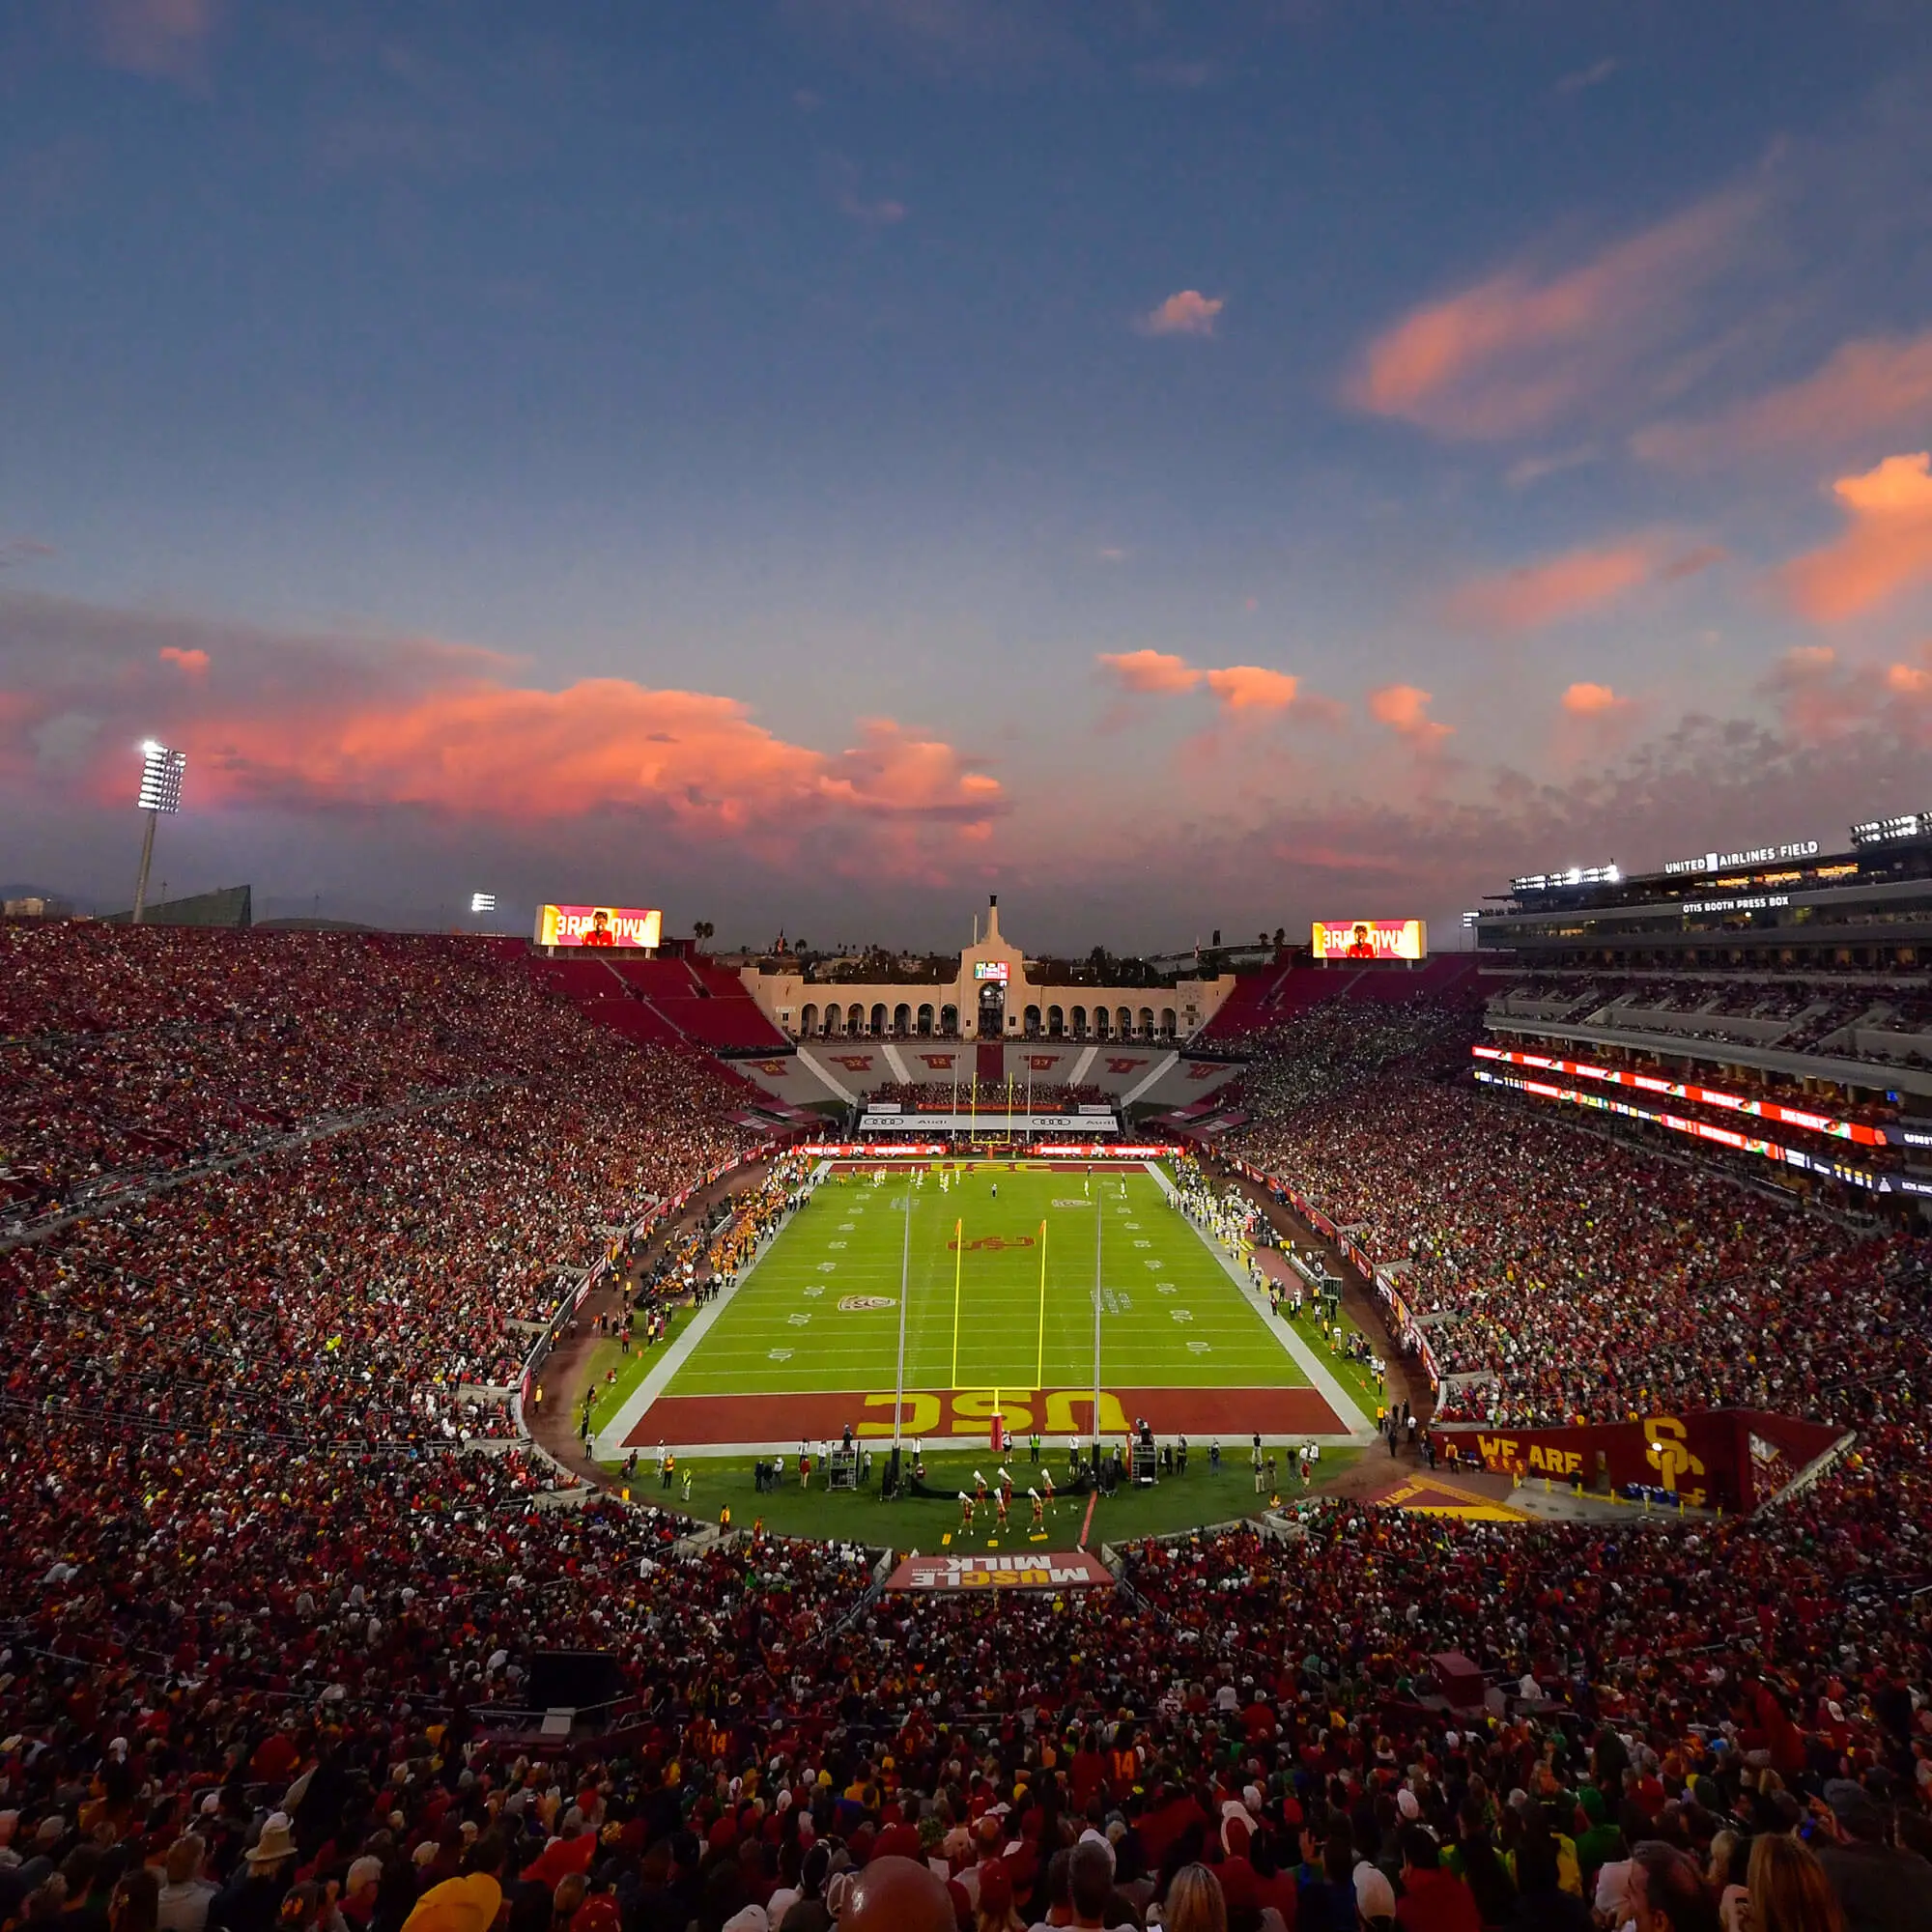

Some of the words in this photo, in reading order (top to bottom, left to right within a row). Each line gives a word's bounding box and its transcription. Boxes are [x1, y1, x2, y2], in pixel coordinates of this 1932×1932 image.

[1664, 858, 1706, 874] UNITED
[1719, 848, 1776, 867] AIRLINES
[1780, 840, 1818, 858] FIELD
[1683, 904, 1702, 913] OTIS
[1704, 900, 1735, 911] BOOTH
[1737, 898, 1767, 909] PRESS
[1770, 895, 1789, 906] BOX
[856, 1390, 1131, 1435] USC
[1529, 1444, 1583, 1475] ARE
[910, 1567, 1090, 1586] MUSCLE
[946, 1555, 1052, 1572] MILK
[711, 1732, 727, 1755] 14
[1113, 1750, 1135, 1779] 14
